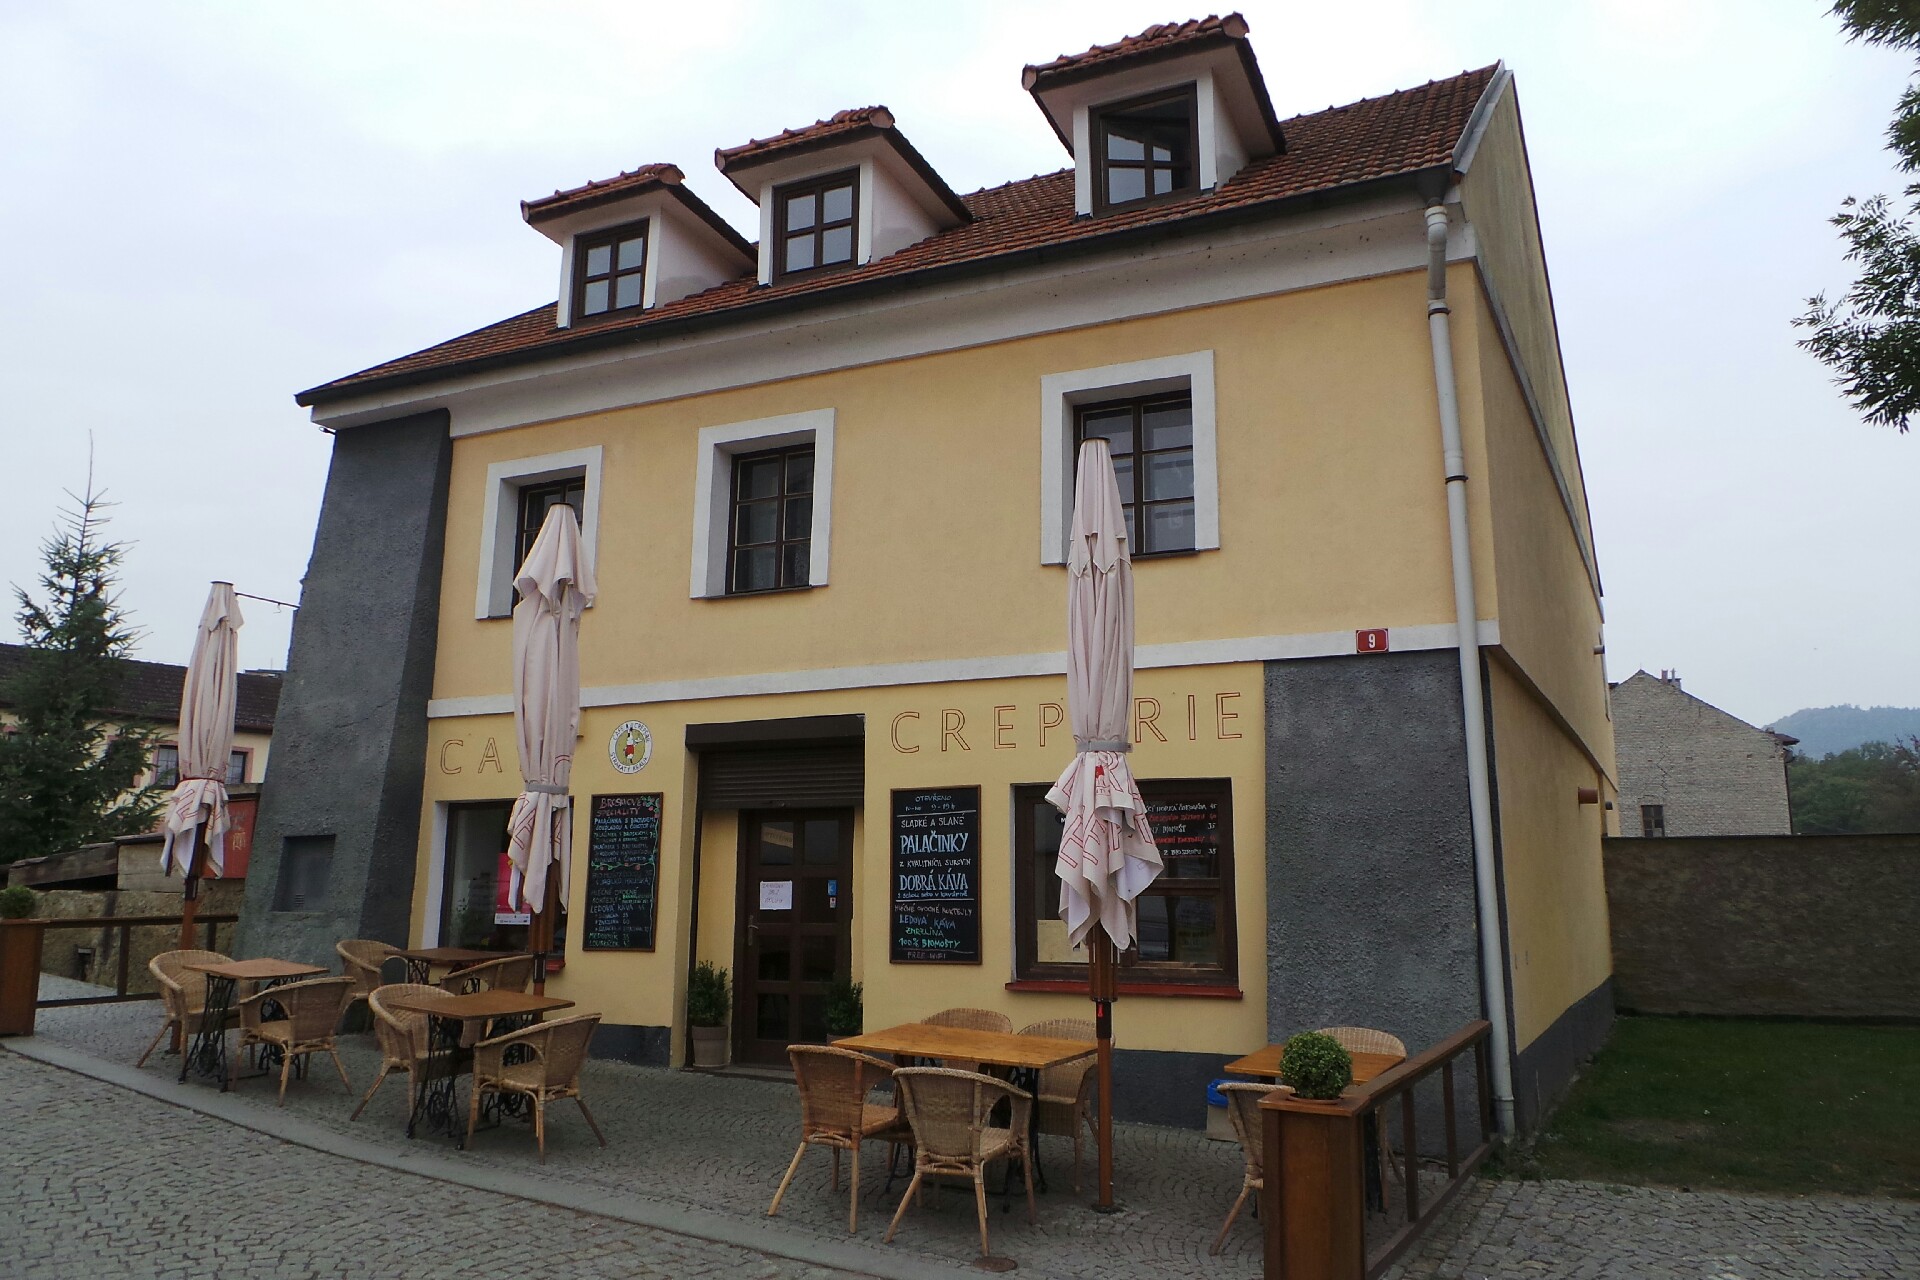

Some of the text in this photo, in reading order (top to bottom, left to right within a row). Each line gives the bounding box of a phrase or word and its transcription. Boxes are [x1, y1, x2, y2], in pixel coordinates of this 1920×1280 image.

[1368, 633, 1376, 649] 9
[891, 692, 1243, 753] CREPRIE
[900, 813, 965, 828] SLADKÉ A SLANÉ
[900, 830, 969, 855] PALAČINKY
[899, 868, 968, 891] DOBRÁ KÁVA
[899, 914, 957, 929] LEDOVÁ KÁVA
